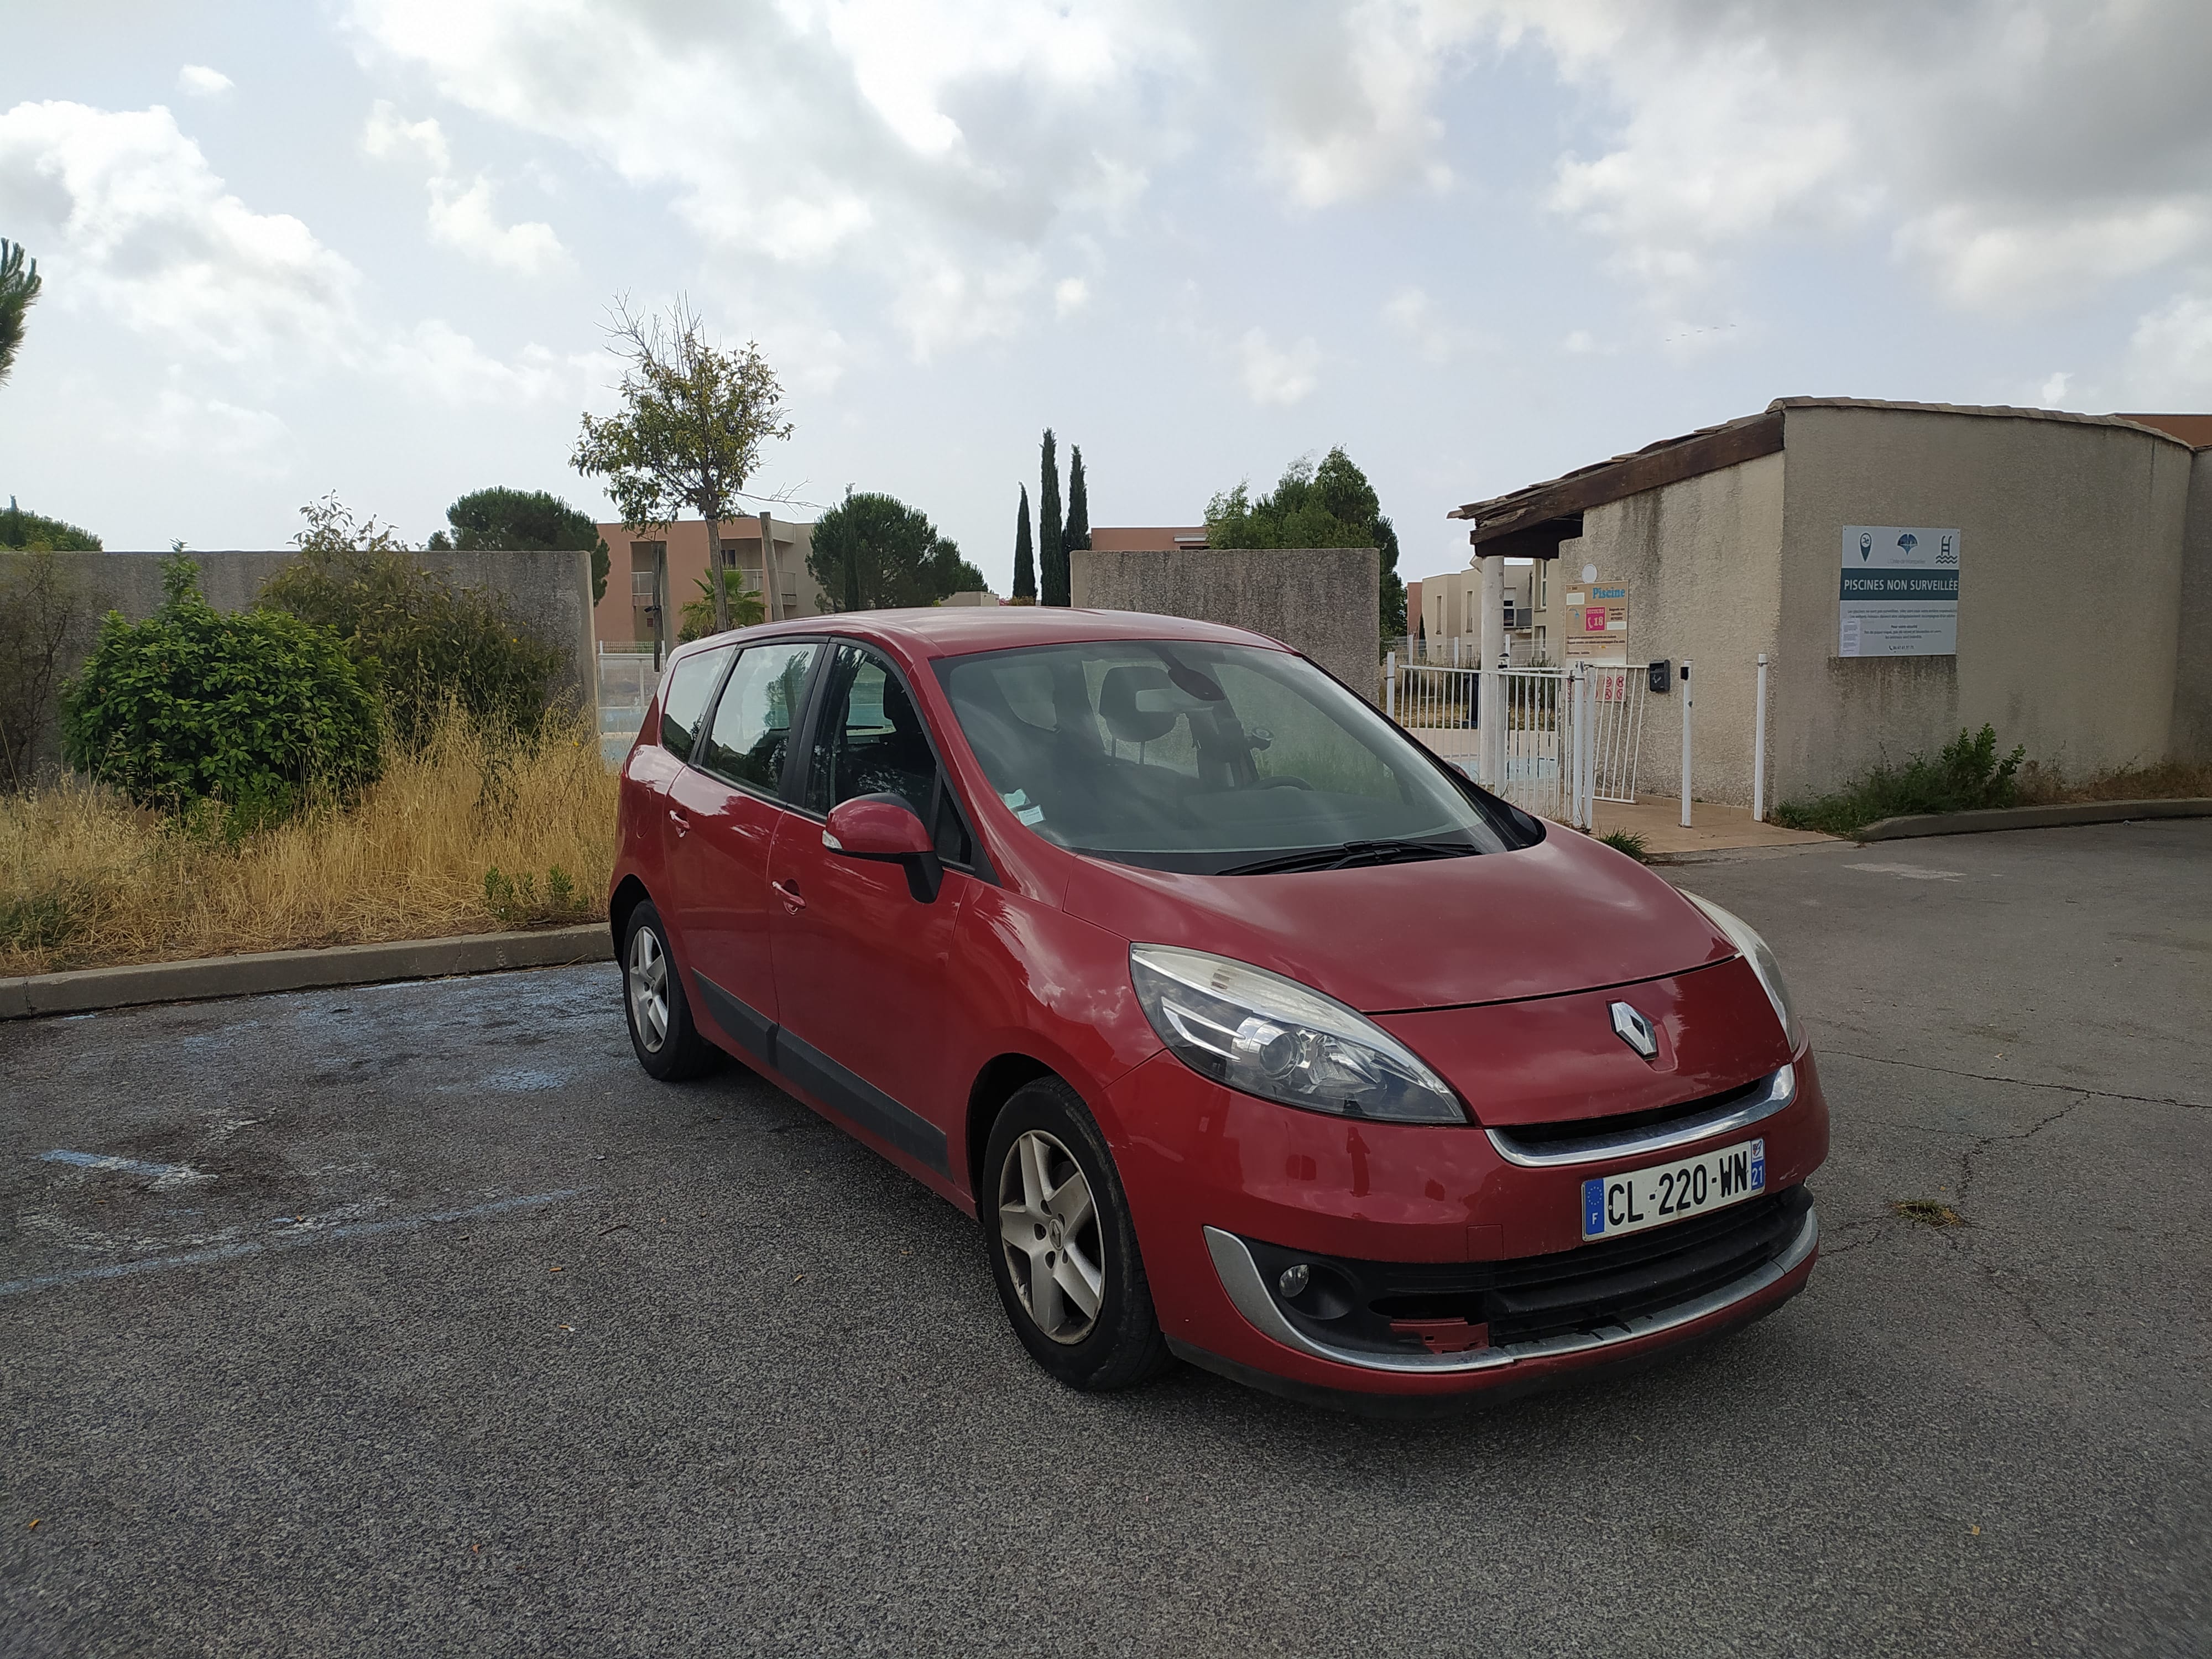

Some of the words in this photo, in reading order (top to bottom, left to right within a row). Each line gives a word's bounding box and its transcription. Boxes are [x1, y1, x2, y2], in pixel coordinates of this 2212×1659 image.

[1844, 579, 1884, 591] PISCINES
[1887, 579, 1907, 591] NON
[1592, 587, 1625, 599] Piscine
[1594, 617, 1604, 626] 18
[1752, 1165, 1763, 1186] 21
[1592, 1213, 1598, 1225] F
